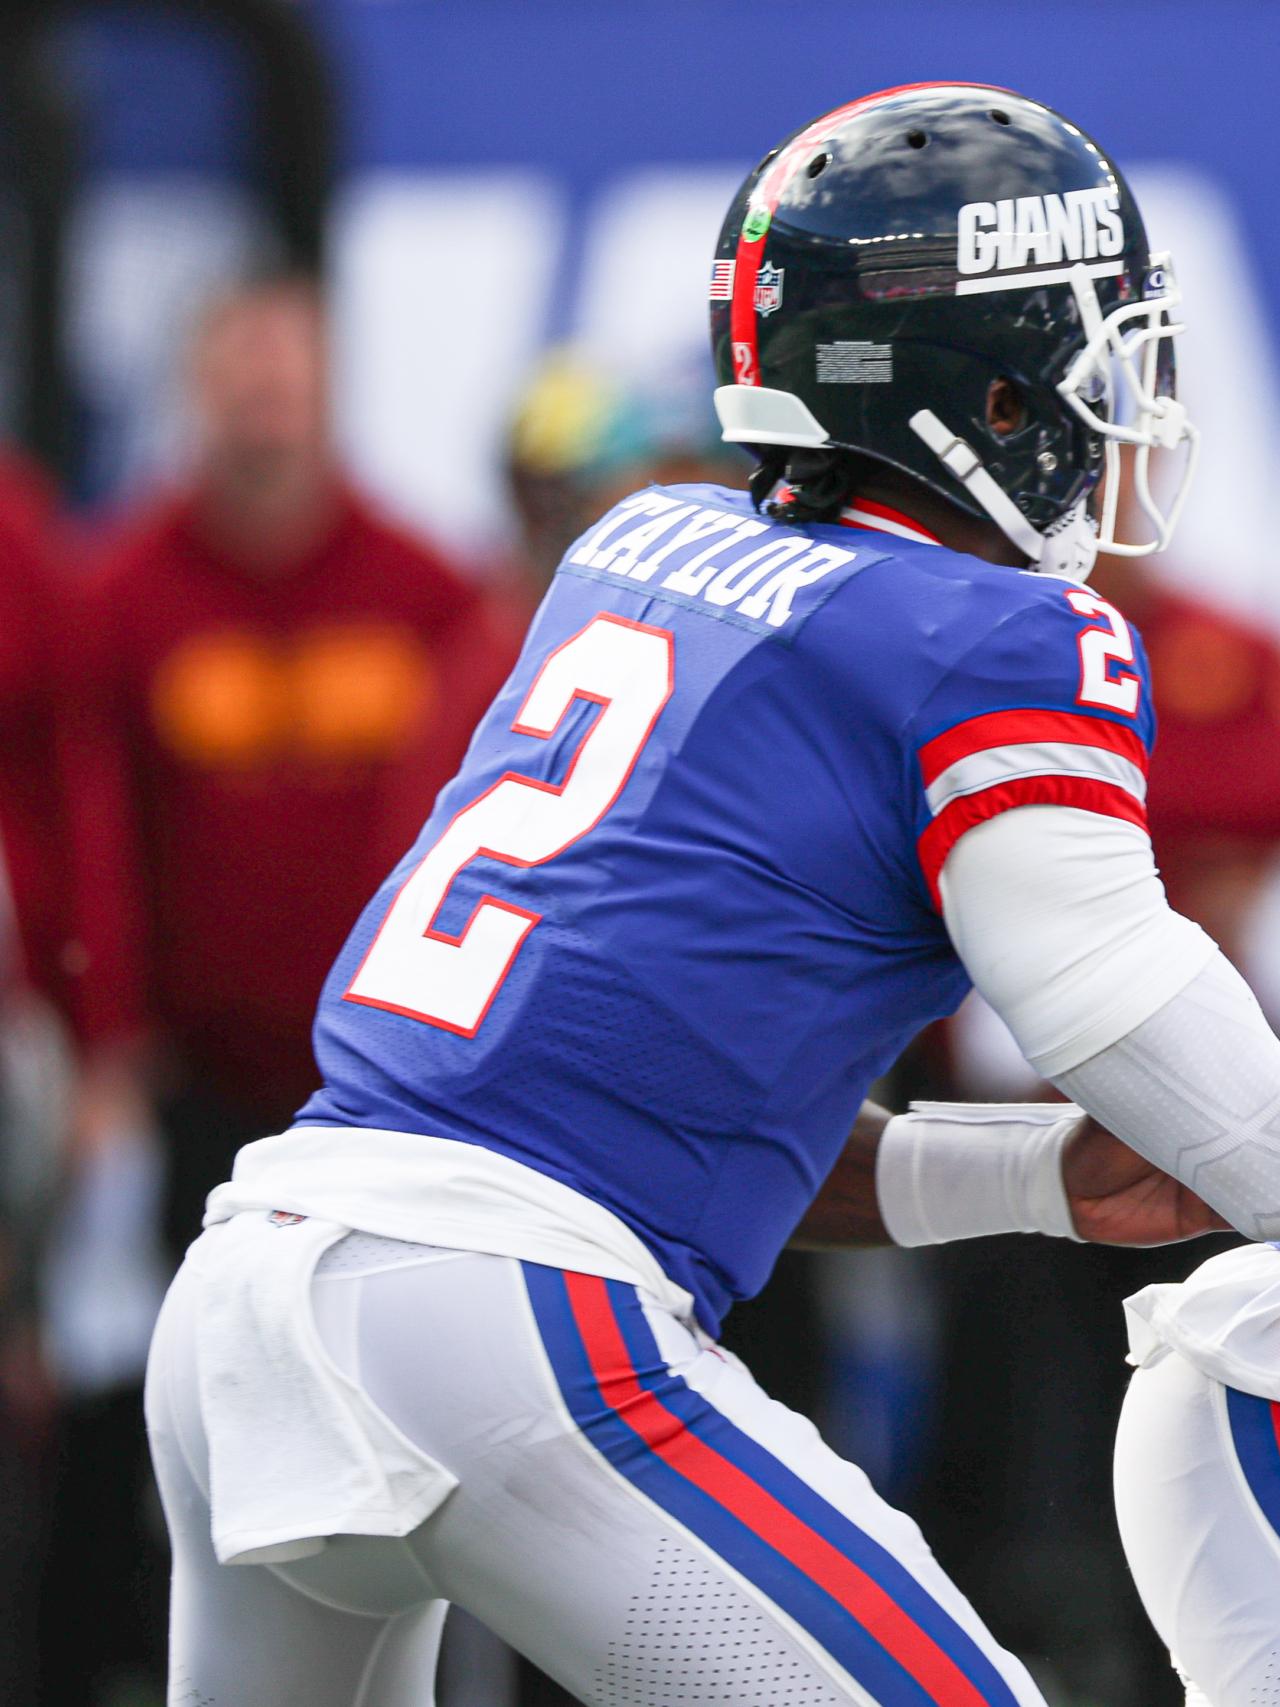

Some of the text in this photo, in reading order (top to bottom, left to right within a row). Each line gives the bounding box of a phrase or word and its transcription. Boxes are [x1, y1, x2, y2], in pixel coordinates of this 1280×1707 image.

[957, 187, 1125, 275] GIANTS
[734, 345, 755, 385] 2
[569, 492, 857, 628] TAYLOR
[1064, 588, 1141, 718] 2
[342, 611, 675, 1038] 2
